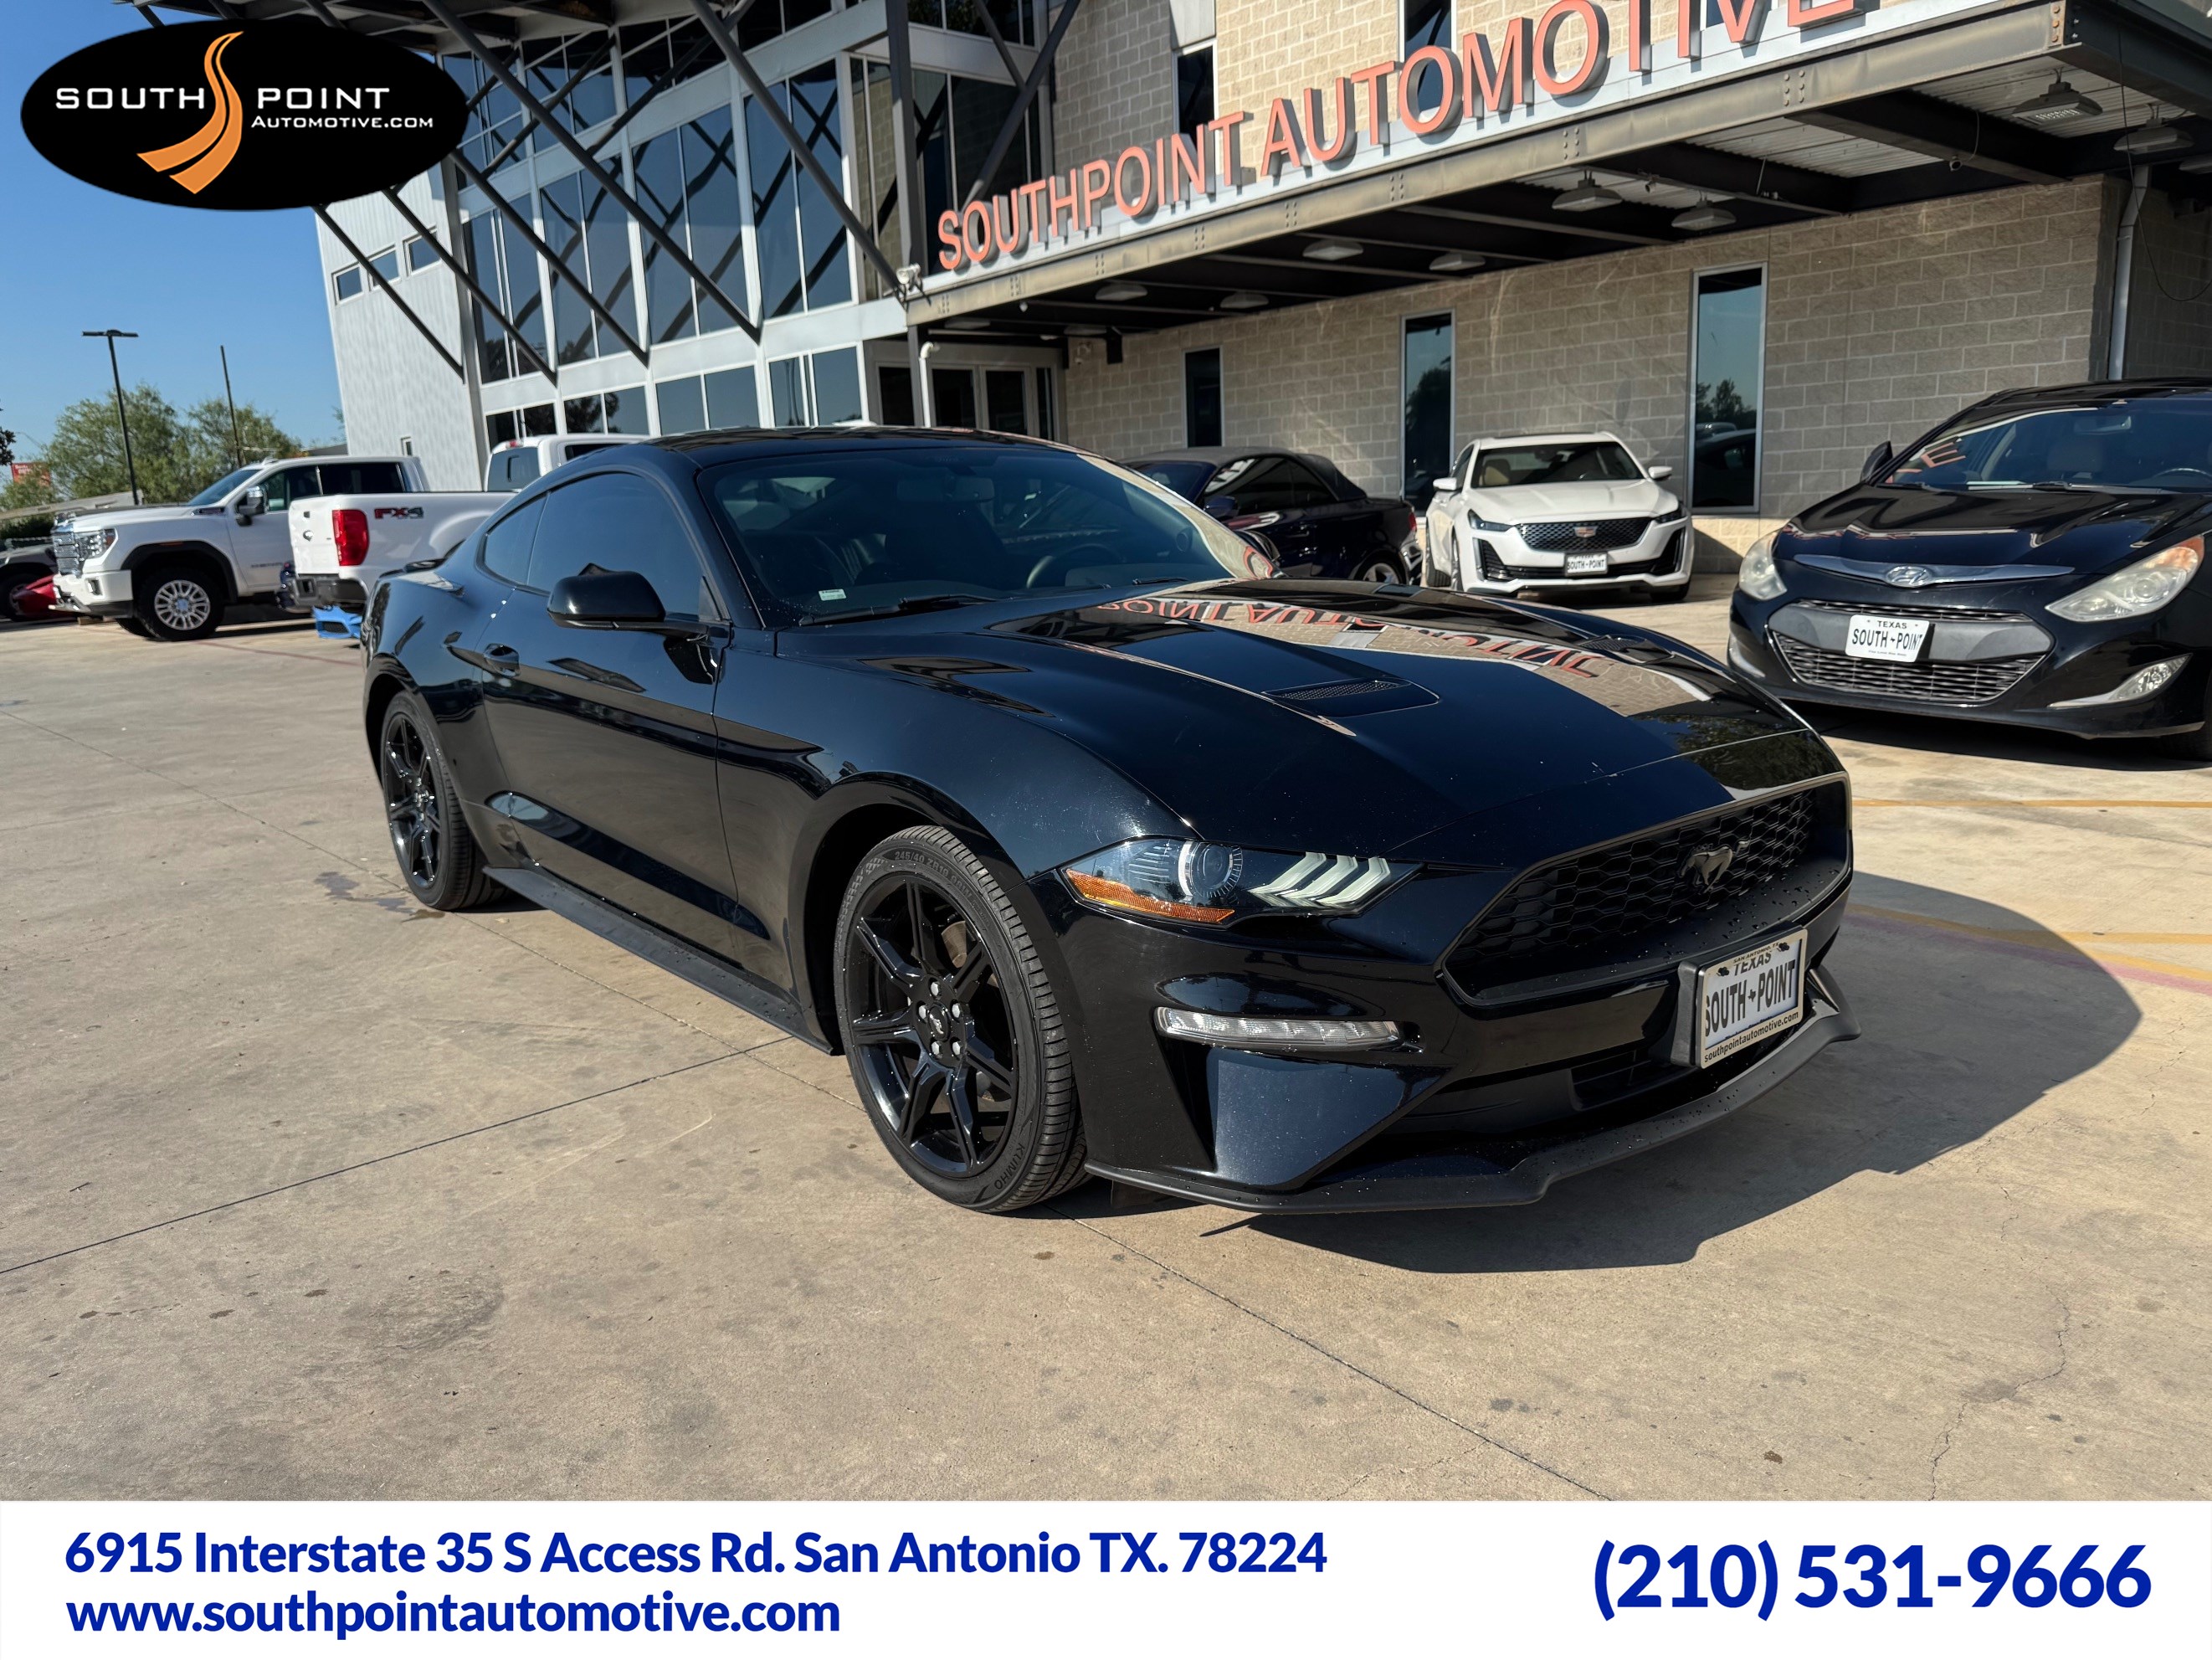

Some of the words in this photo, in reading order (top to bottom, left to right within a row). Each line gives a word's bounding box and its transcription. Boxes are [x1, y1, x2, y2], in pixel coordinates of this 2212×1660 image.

[938, 110, 1245, 270] SOUTHPOINT
[1260, 0, 1853, 177] AUTOMOTI
[374, 506, 423, 519] FX4
[1877, 620, 1907, 630] TEXAS
[1852, 629, 1888, 648] SOUTH
[1896, 632, 1923, 650] POINT
[895, 851, 925, 864] 245/40
[927, 858, 949, 877] ZR19
[1734, 952, 1772, 976] TEXAS
[1706, 979, 1748, 1037] SOUTH
[1758, 959, 1796, 1012] POINT
[1704, 1011, 1799, 1063] southpointautomotive.com
[994, 1143, 1025, 1190] KUMHO
